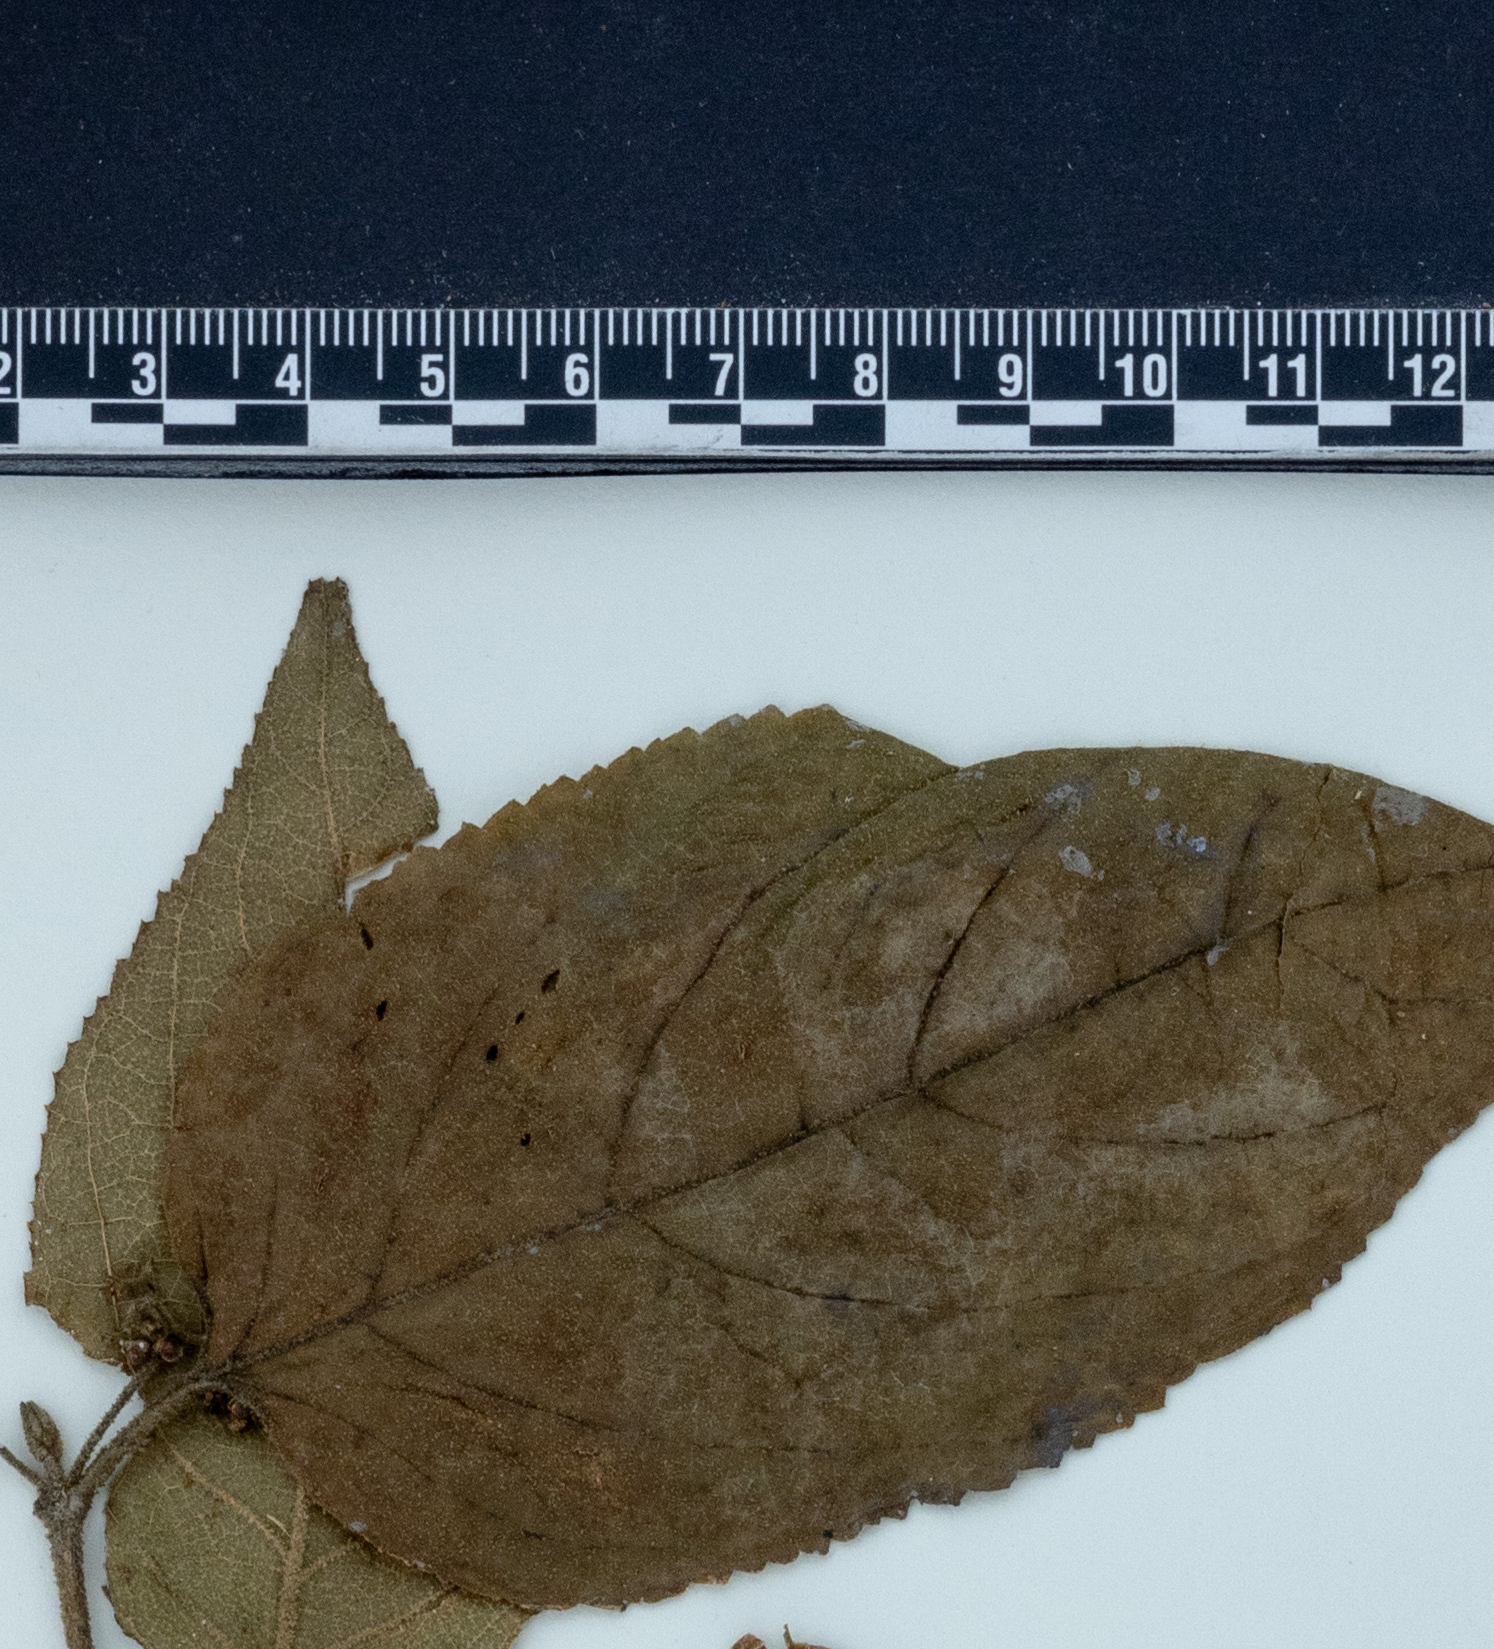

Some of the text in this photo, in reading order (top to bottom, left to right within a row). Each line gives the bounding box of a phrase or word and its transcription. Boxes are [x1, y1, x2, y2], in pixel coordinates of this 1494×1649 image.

[132, 352, 156, 395] 3
[275, 354, 301, 396] 4
[421, 354, 445, 397] 5
[565, 353, 589, 396] 6
[710, 353, 733, 396] 7
[854, 353, 878, 396] 8
[998, 354, 1022, 397] 9
[1115, 354, 1167, 397] 10
[1259, 354, 1305, 397] 11
[1404, 354, 1455, 397] 12
